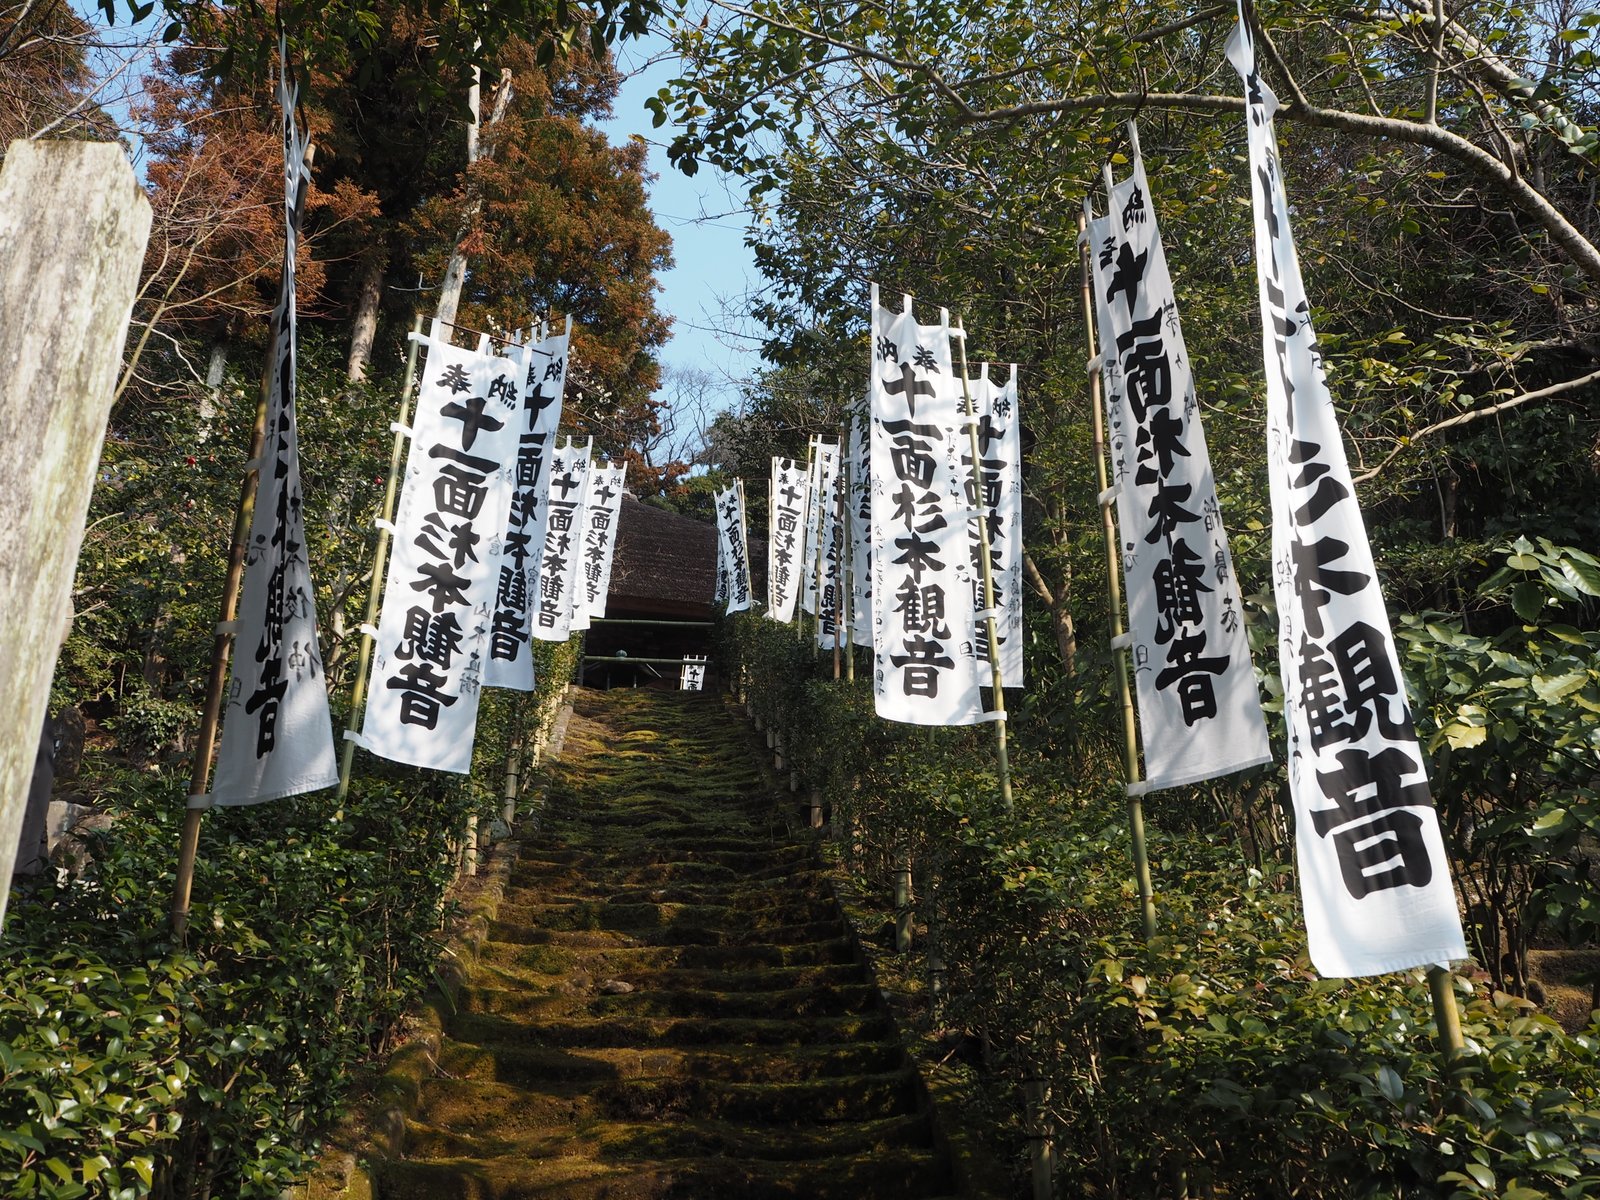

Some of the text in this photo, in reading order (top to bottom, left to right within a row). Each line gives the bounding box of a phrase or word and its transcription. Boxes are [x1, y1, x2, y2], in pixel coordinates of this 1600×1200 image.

[722, 505, 749, 604] 十一面杉本観音
[882, 362, 955, 698] 十一面杉本観音
